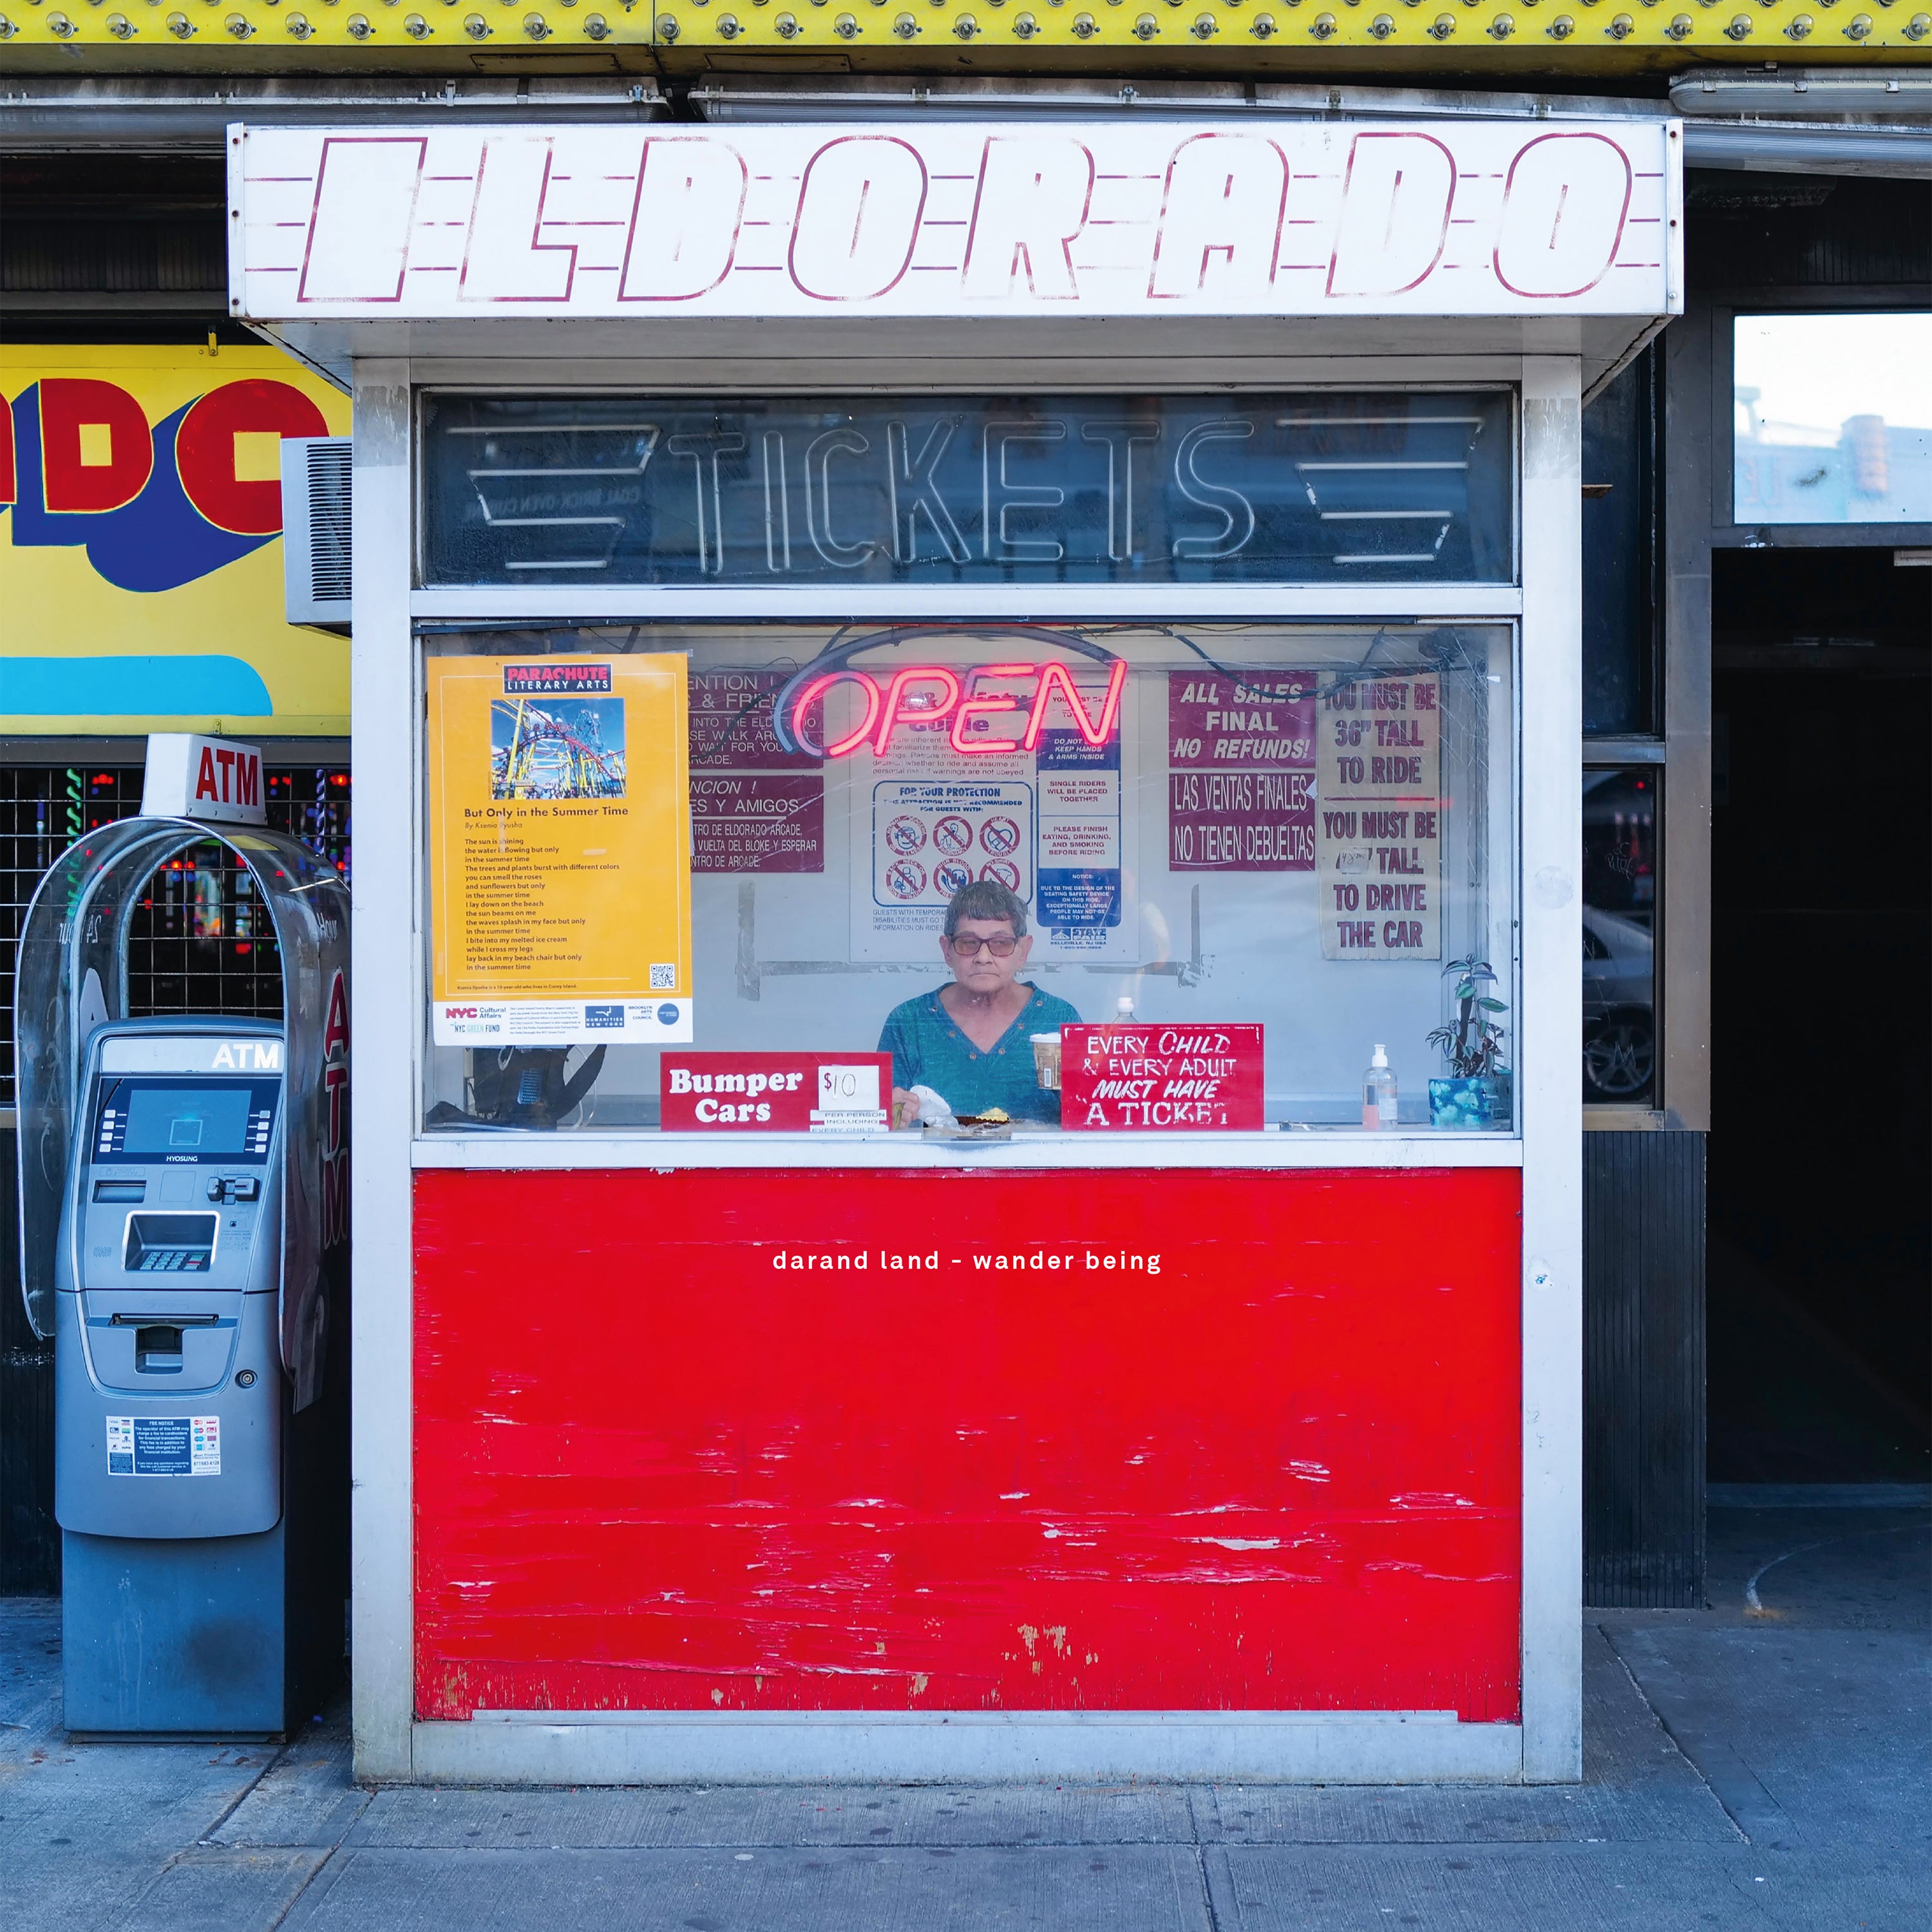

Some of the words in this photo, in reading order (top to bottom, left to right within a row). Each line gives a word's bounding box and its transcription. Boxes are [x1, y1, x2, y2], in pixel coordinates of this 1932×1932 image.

[0, 377, 330, 535] DO
[667, 419, 1255, 576] TICKETS
[507, 667, 607, 681] PARACHUTE
[507, 680, 568, 690] LITERARY
[576, 680, 609, 689] ARTS
[688, 676, 757, 690] ENTION
[1180, 684, 1218, 703] ALL
[1233, 684, 1303, 704] SALES
[1362, 684, 1409, 710] MUST
[1414, 684, 1436, 710] BE
[792, 661, 1128, 759] OPEN
[1206, 712, 1278, 731] FINAL
[693, 718, 719, 726] INTO
[1375, 721, 1425, 746] TALL
[1174, 739, 1201, 758] NO
[1214, 739, 1310, 759] REFUNDS!
[196, 746, 258, 806] ATM
[1337, 757, 1365, 783] TO
[1372, 757, 1422, 783] RIDE
[900, 788, 916, 796] FOR
[920, 788, 943, 796] YOUR
[947, 788, 1000, 797] PROTECTION
[1175, 776, 1198, 811] LAS
[1204, 776, 1253, 811] VENTAS
[1257, 775, 1307, 811] FINALES
[464, 809, 482, 817] But
[486, 808, 513, 819] Only
[517, 808, 527, 817] in
[602, 807, 629, 815] Time
[715, 800, 726, 811] Y
[735, 799, 799, 813] AMIGOS
[712, 824, 722, 835] DE
[724, 824, 766, 835] ELDORADO
[770, 824, 802, 835] ARCADE.
[1323, 812, 1356, 838] YOU
[1362, 812, 1409, 838] MUST
[1414, 812, 1437, 838] BE
[698, 840, 725, 851] VUELTA
[728, 840, 742, 851] DEL
[746, 840, 770, 851] BLOKE
[773, 840, 779, 851] Y
[781, 840, 817, 851] ESPERAR
[1175, 827, 1193, 860] NO
[1198, 826, 1242, 860] TIENEN
[1246, 826, 1314, 861] DEBUELTAS
[715, 856, 725, 867] DE
[1376, 848, 1424, 874] TALL
[1334, 884, 1359, 911] TO
[1366, 884, 1426, 910] DRIVE
[1338, 922, 1375, 947] THE
[1383, 921, 1423, 947] CAR
[446, 1008, 477, 1018] NYC
[1087, 1036, 1149, 1054] EVERY
[1159, 1031, 1230, 1055] CHILD
[211, 1043, 279, 1068] ATM
[1109, 1059, 1173, 1076] EVERY
[1179, 1059, 1236, 1077] ADULT
[669, 1070, 803, 1093] Bumper
[1092, 1079, 1157, 1099] MUST
[1164, 1079, 1220, 1099] HAVE
[324, 969, 350, 1249] ATM
[695, 1099, 771, 1123] Cars
[1084, 1103, 1109, 1126] A
